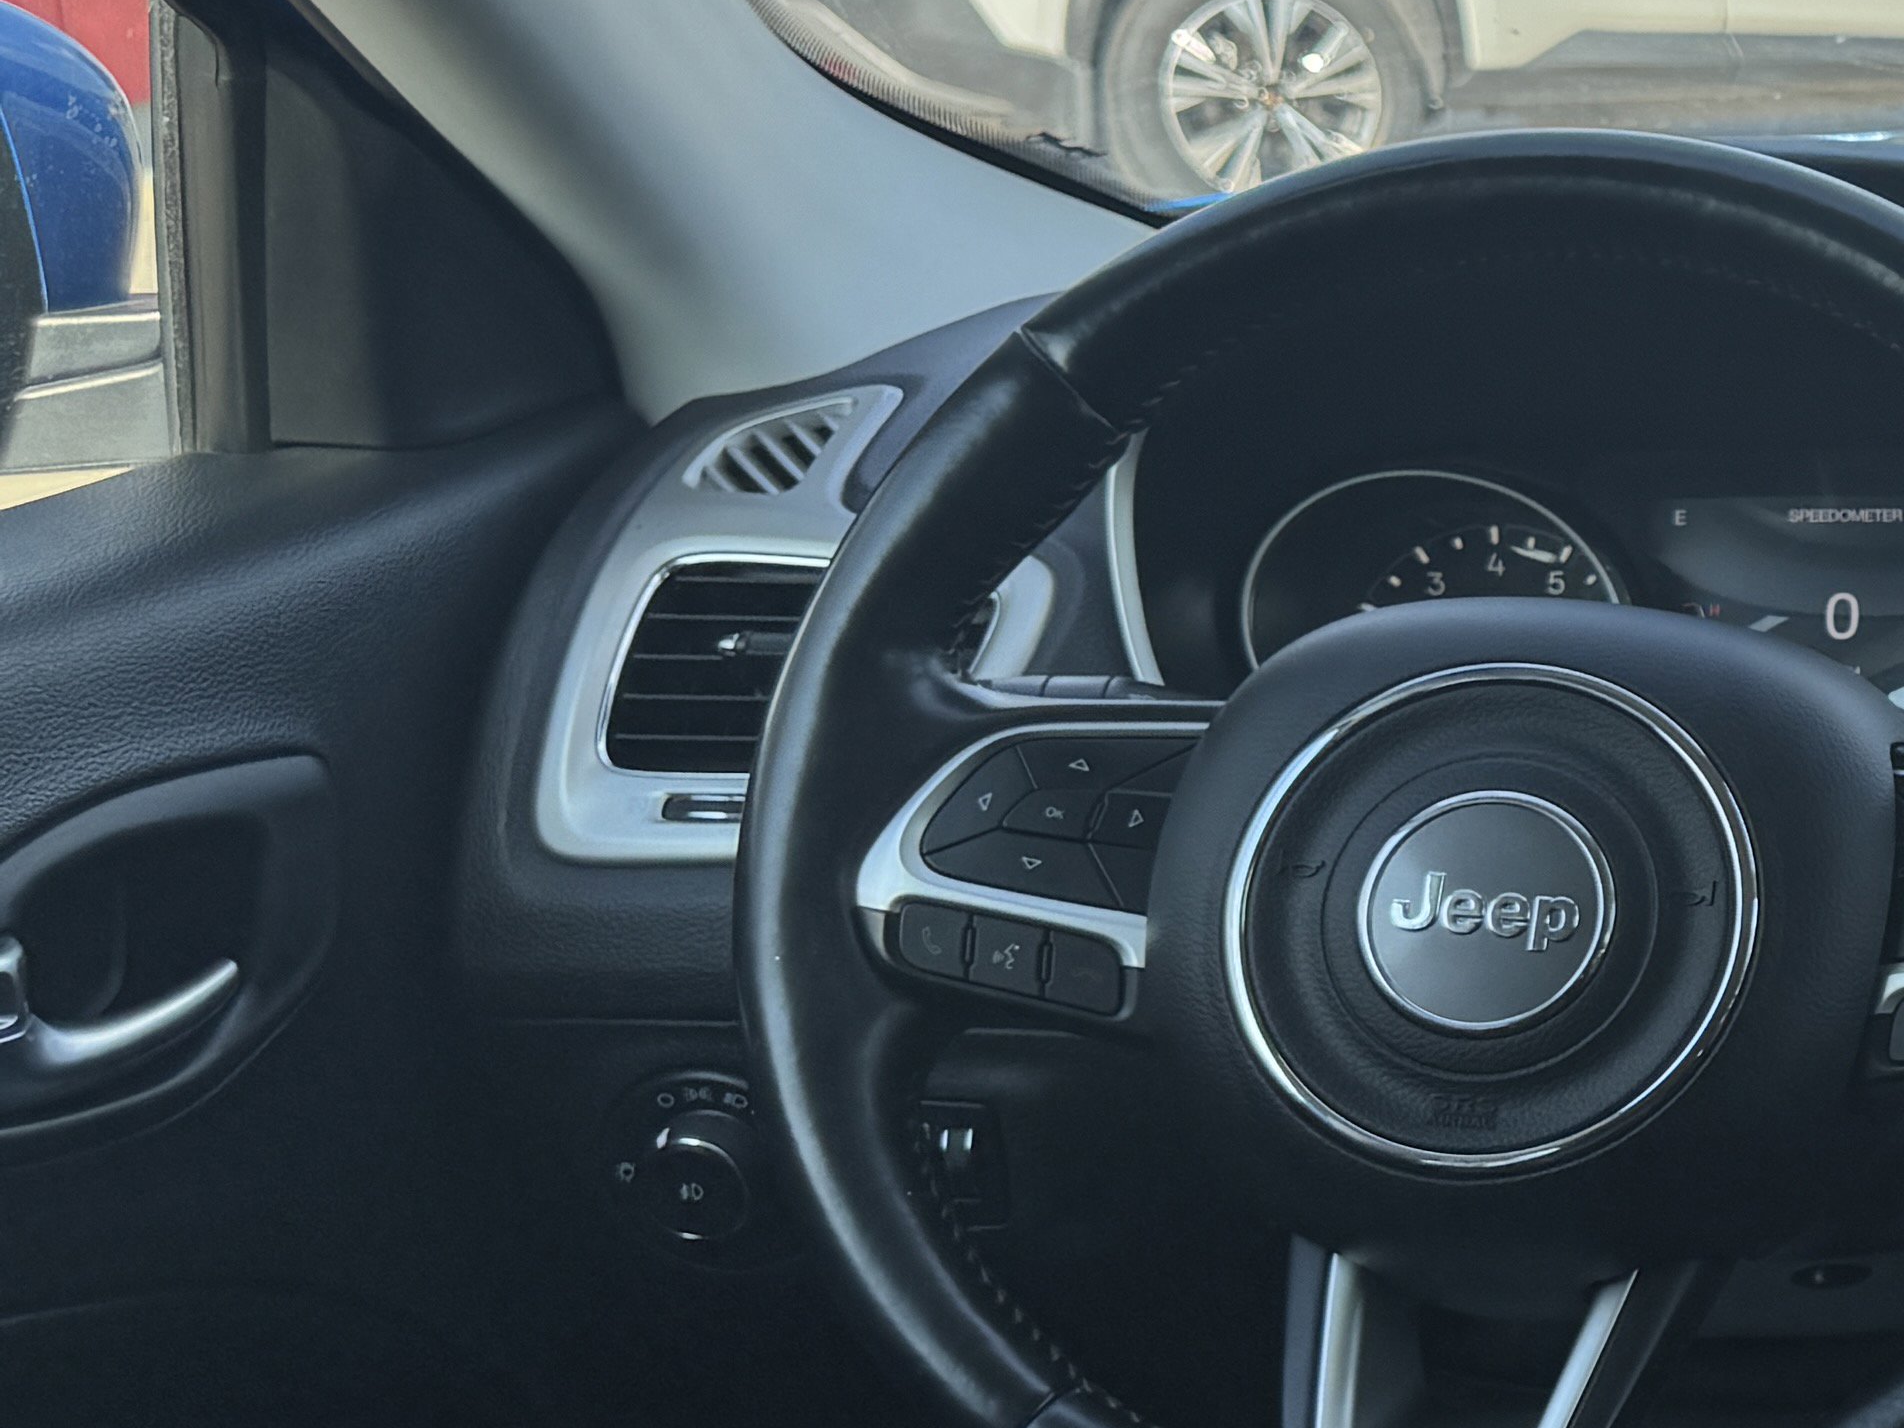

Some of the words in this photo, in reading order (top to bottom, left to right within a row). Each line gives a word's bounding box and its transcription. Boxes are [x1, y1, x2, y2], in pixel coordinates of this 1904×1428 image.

[1674, 510, 1688, 526] E
[1788, 509, 1904, 523] SPEEDOMETER
[1487, 553, 1506, 576] 4
[1426, 572, 1446, 596] 3
[1547, 571, 1566, 595] 5
[1825, 592, 1860, 640] 0
[1390, 870, 1581, 953] Jeep
